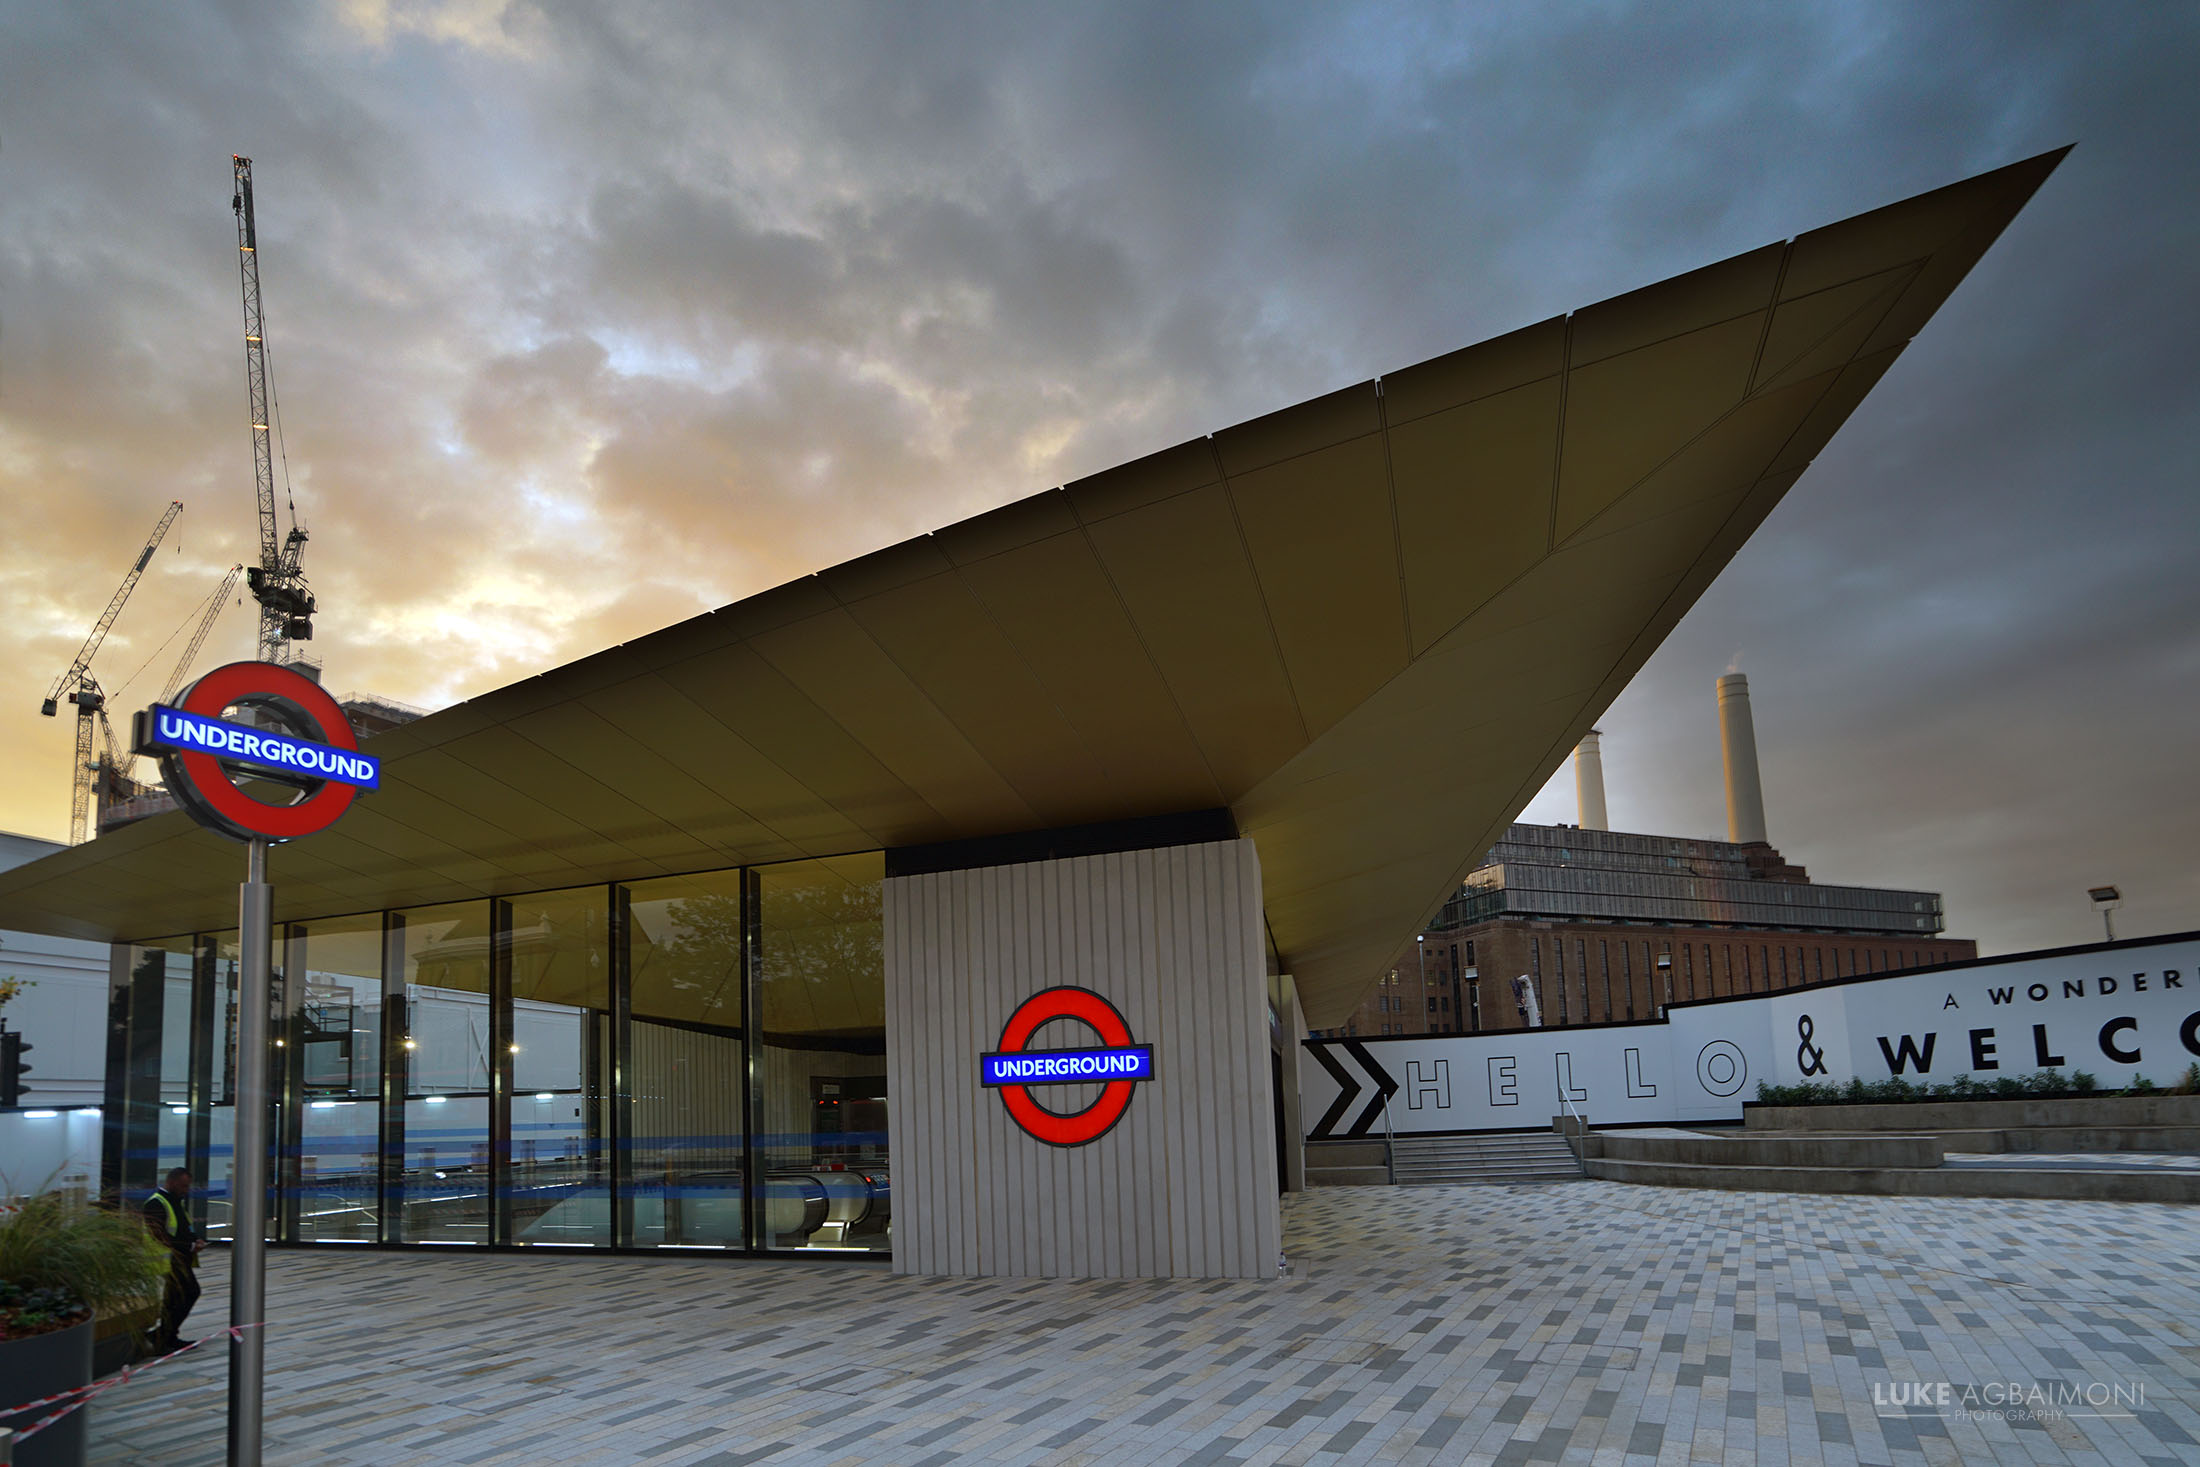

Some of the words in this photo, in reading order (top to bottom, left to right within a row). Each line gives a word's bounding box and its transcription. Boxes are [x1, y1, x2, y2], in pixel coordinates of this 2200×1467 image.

[159, 714, 374, 780] UNDERGROUND
[1943, 993, 1960, 1010] A
[1988, 967, 2200, 1006] WONDER
[994, 1055, 1140, 1078] UNDERGROUND
[1406, 1039, 1748, 1110] HELLO
[1797, 1014, 1828, 1077] &
